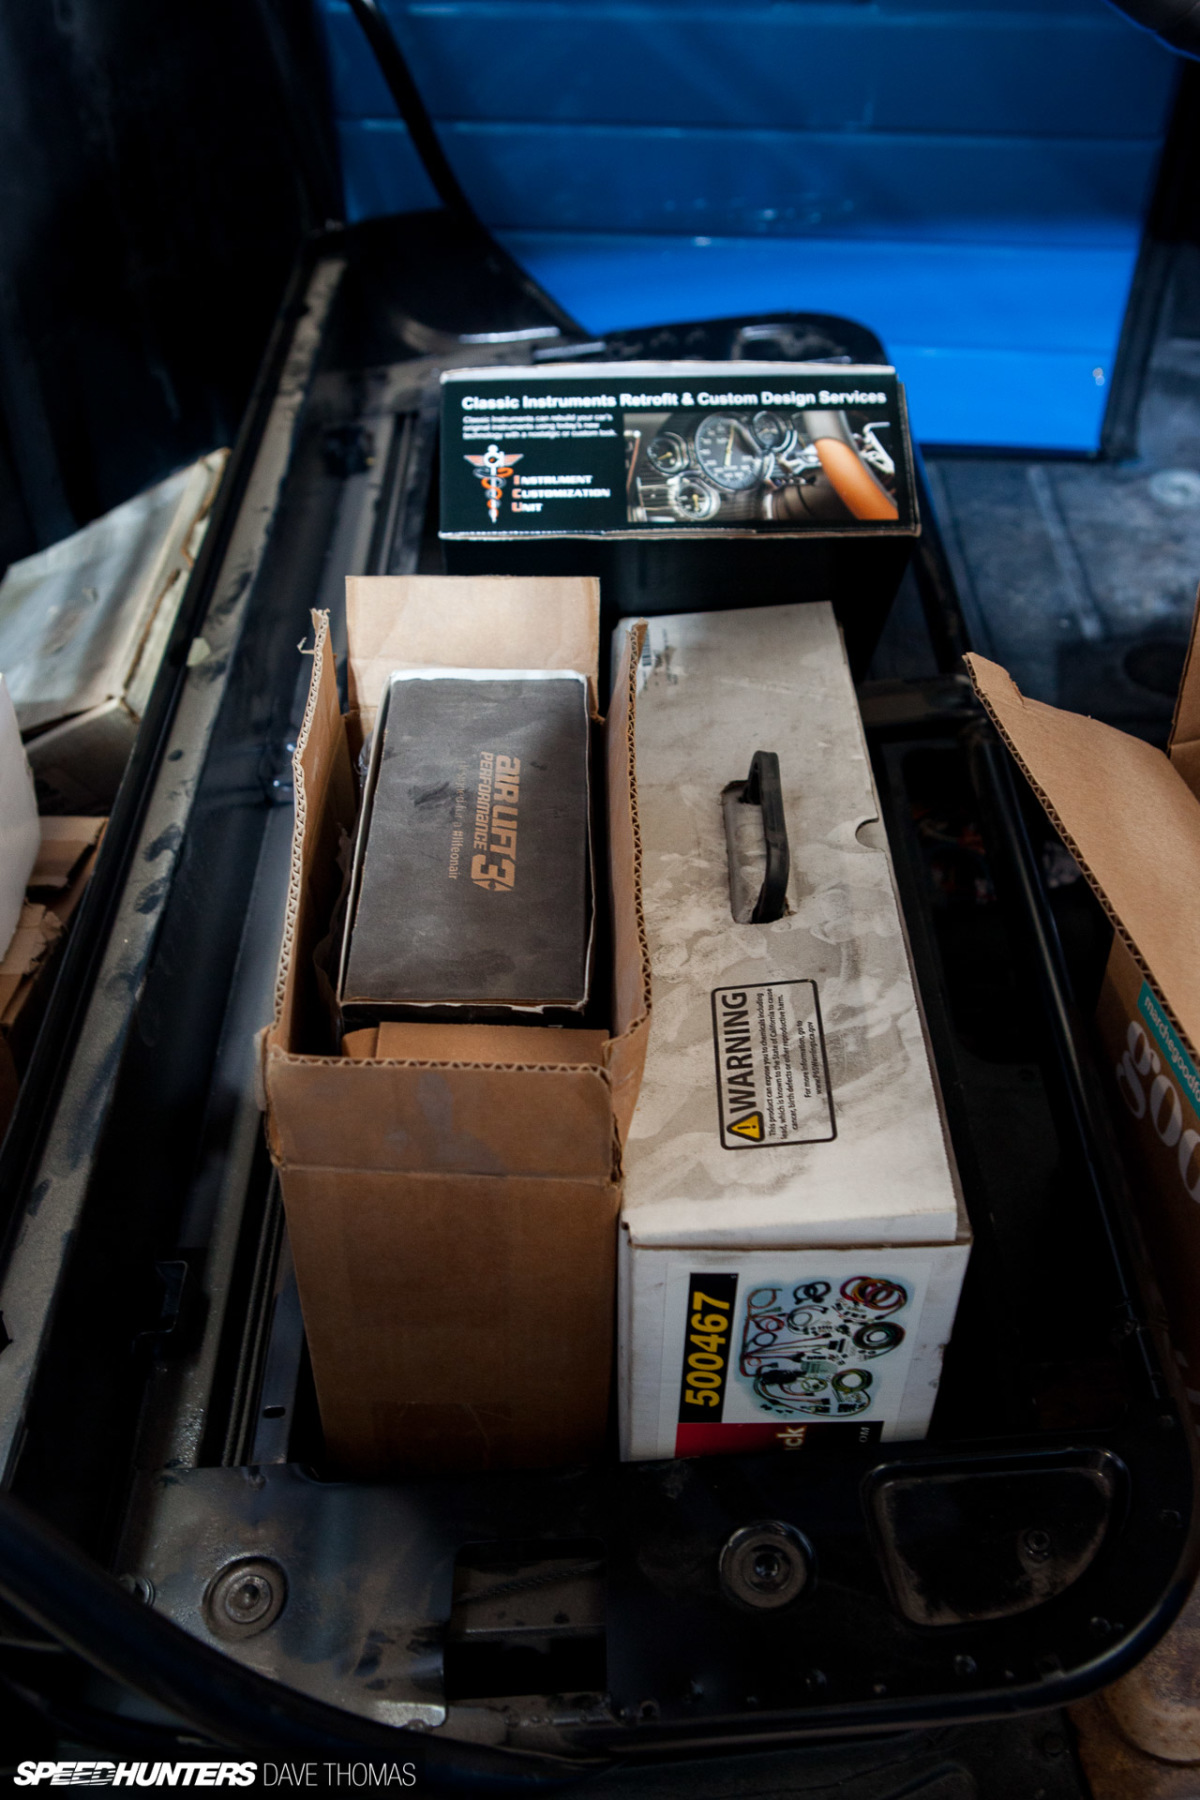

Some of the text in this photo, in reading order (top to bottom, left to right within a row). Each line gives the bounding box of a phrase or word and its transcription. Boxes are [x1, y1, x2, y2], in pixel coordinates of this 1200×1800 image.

[462, 390, 886, 410] Classic Instruments Retrofit & Custom Design Services
[513, 475, 593, 485] INSTRUMENT
[512, 488, 611, 499] CUSTOMIZATION
[511, 502, 543, 512] UNIT
[448, 830, 463, 880] #lifeonair
[756, 993, 765, 1018] including
[777, 995, 785, 1010] harm.
[758, 1019, 767, 1046] chemicals
[768, 1011, 777, 1037] California
[779, 1011, 790, 1046] reproductive
[797, 1026, 805, 1035] go
[722, 992, 756, 1113] WARNING
[763, 1054, 771, 1065] you
[771, 1045, 780, 1059] State
[782, 1047, 791, 1063] other
[797, 1036, 808, 1071] information,
[763, 1065, 773, 1086] expose
[784, 1071, 795, 1092] defects
[802, 1072, 810, 1087] more
[775, 1078, 783, 1098] known
[786, 1093, 795, 1107] birth
[766, 1099, 776, 1122] product
[777, 1105, 787, 1123] which
[789, 1108, 798, 1130] cancer,
[768, 1124, 776, 1136] This
[780, 1124, 788, 1139] lead,
[684, 1290, 731, 1408] 500467
